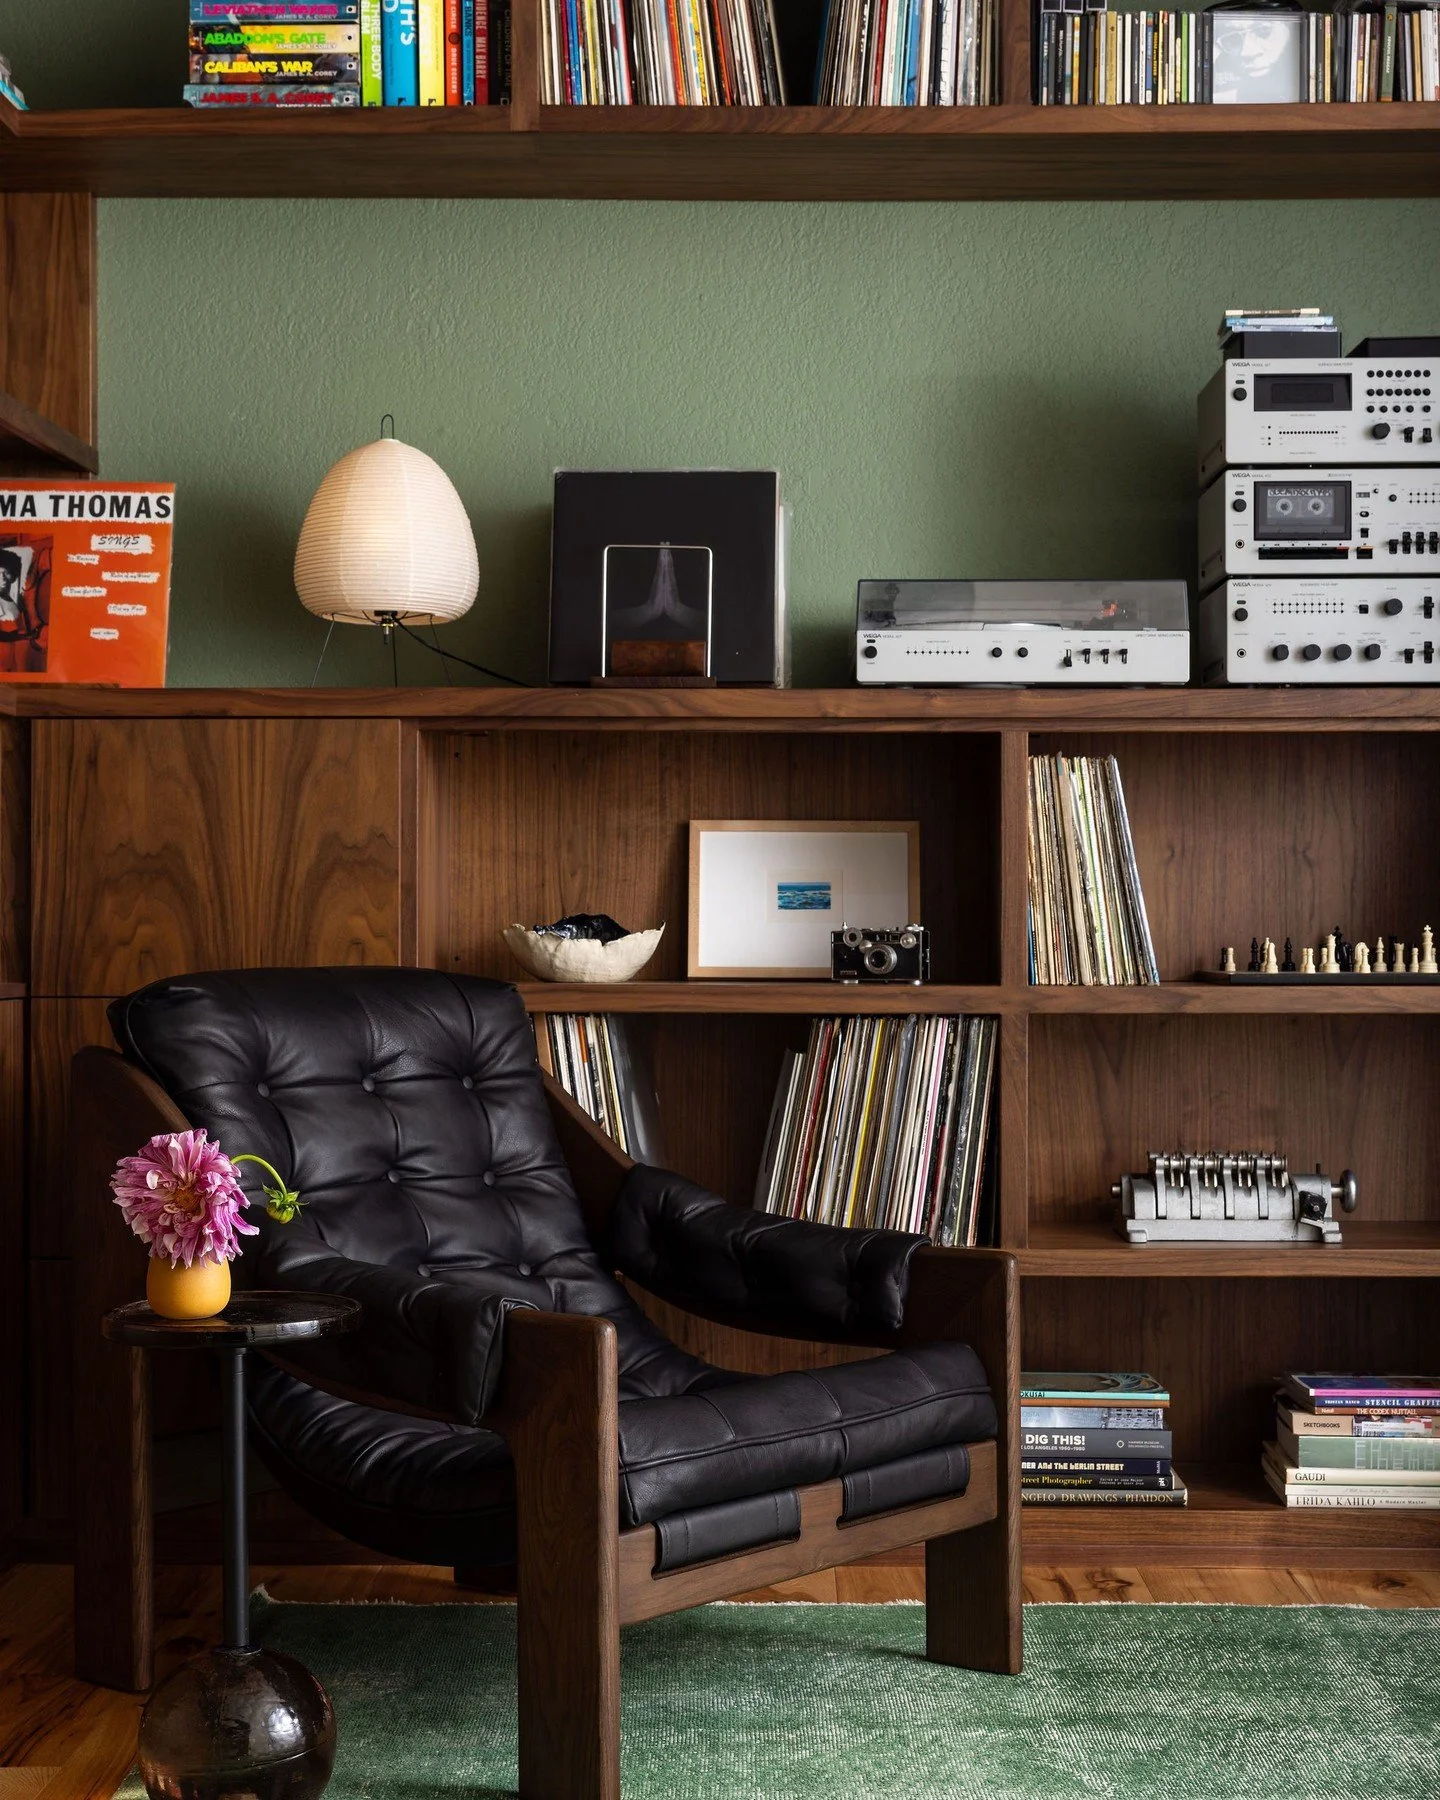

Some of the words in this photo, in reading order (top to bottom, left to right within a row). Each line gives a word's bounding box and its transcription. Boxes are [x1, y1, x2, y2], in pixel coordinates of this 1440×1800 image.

[204, 4, 286, 16] LEVIATHAN
[288, 4, 338, 16] WAKES
[204, 33, 284, 45] ABADDON'S
[288, 33, 326, 44] GATE
[372, 2, 382, 78] THREE-BODY
[476, 37, 486, 53] MAX
[205, 61, 278, 73] CALIBAN'S
[281, 61, 313, 72] WAR
[476, 55, 486, 79] BARRY
[201, 92, 248, 104] JAMES
[0, 494, 36, 517] MA
[49, 494, 171, 518] THOMAS
[98, 536, 140, 548] SINGS
[1026, 1434, 1048, 1445] DIG
[1052, 1435, 1085, 1446] THIS!
[1042, 1476, 1092, 1486] Photographer
[1062, 1493, 1118, 1502] DRAWINGS
[1296, 1497, 1332, 1506] FRIDA
[1336, 1497, 1375, 1506] KAHLO
